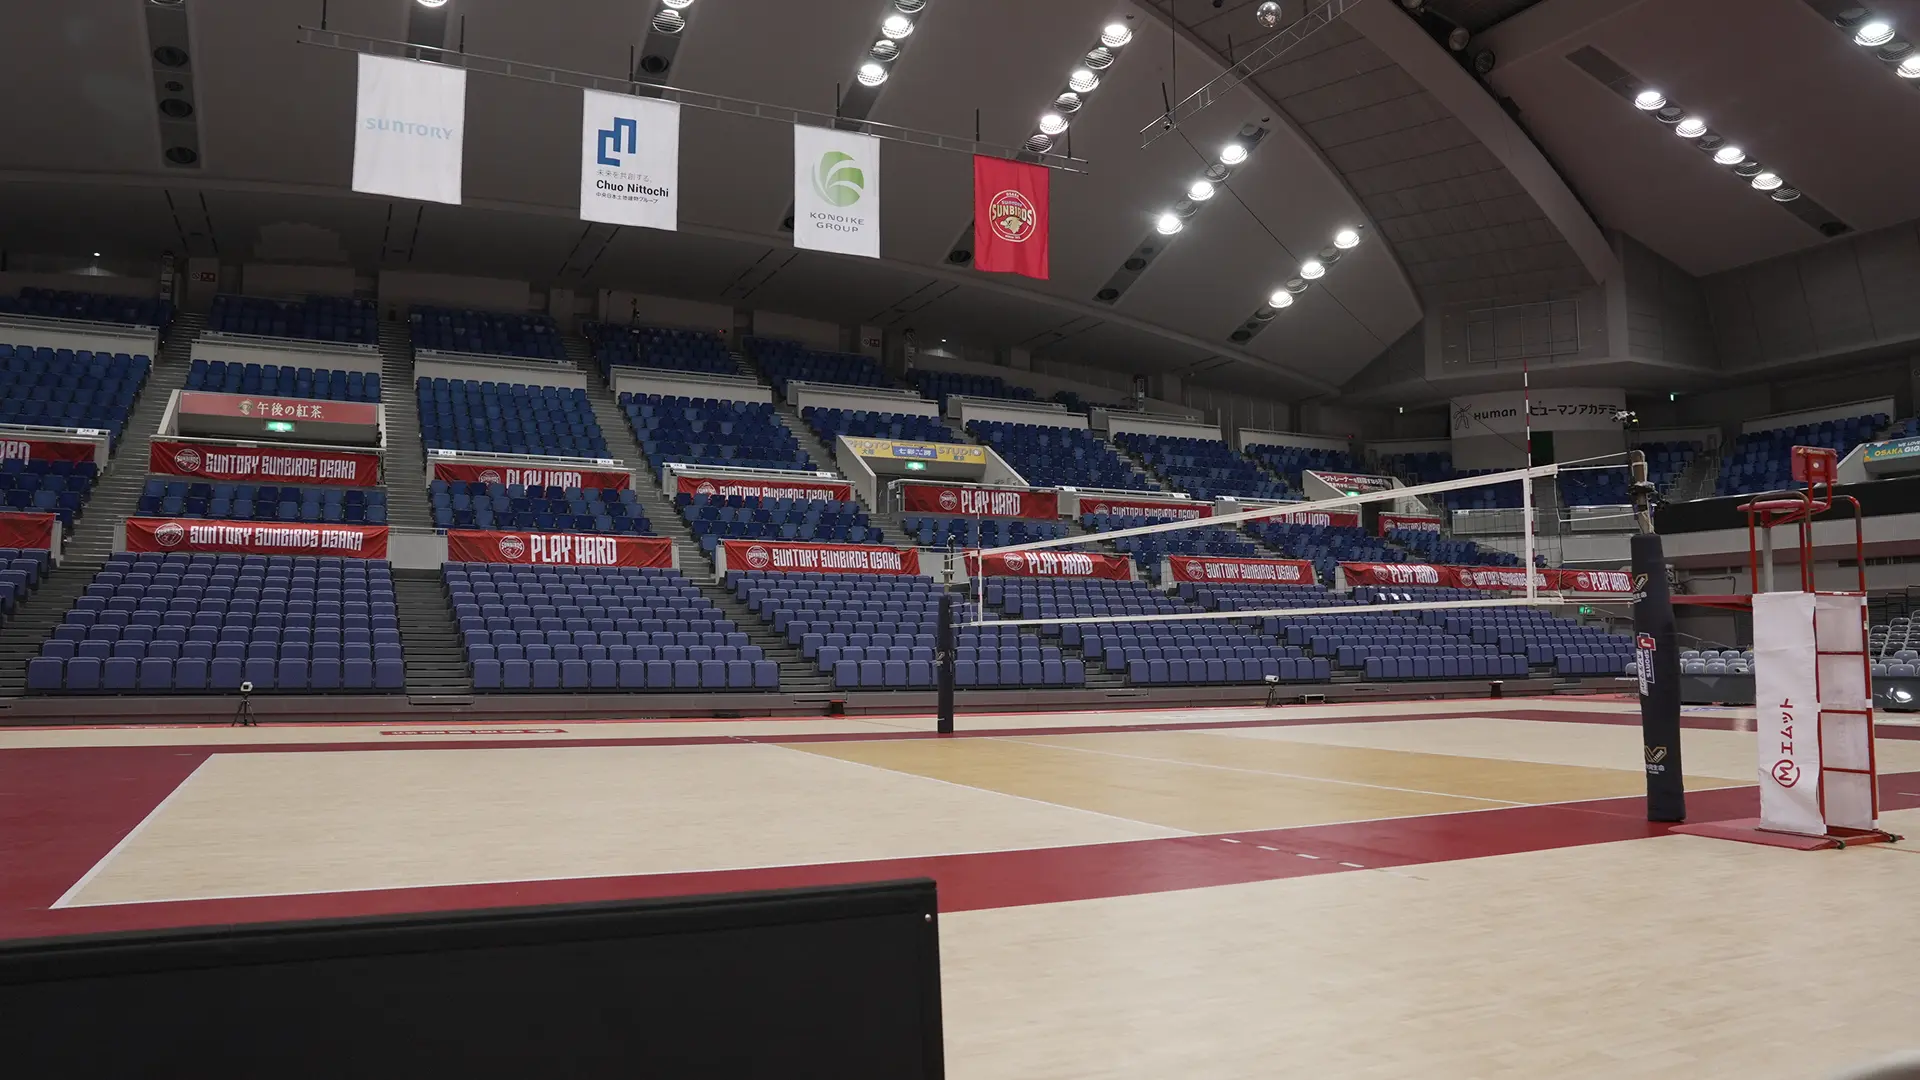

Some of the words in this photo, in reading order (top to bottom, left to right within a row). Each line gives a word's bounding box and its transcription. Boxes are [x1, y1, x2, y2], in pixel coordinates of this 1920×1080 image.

[596, 179, 624, 192] Chuo
[627, 183, 669, 198] Nittochi
[809, 212, 865, 226] KONOIKE
[991, 204, 1033, 226] SUNBIRDS
[816, 221, 859, 233] GROUP
[256, 401, 323, 419] 午後の紅茶
[1874, 447, 1904, 457] OSAKA
[205, 453, 259, 474] SUNTORY
[261, 456, 318, 477] SUNBIRDS
[319, 459, 356, 480] OSAKA
[960, 489, 990, 514] PLAY
[991, 491, 1021, 515] HARD
[190, 525, 252, 546] SUNTORY
[254, 528, 319, 548] SUNBIRDS
[321, 529, 364, 551] OSAKA
[530, 534, 571, 563] PLAY
[575, 536, 618, 565] HARD
[772, 548, 818, 568] SUNTORY
[820, 550, 869, 569] SUNBIRDS
[870, 551, 902, 570] OSAKA
[1024, 552, 1059, 575] PLAY
[1058, 553, 1093, 575] HARD
[1205, 563, 1239, 579] SUNTORY
[1240, 563, 1276, 580] SUNBIRDS
[1276, 565, 1300, 580] OSAKA
[1386, 565, 1414, 583] PLAY
[1589, 572, 1611, 591] PLAY
[1610, 573, 1631, 591] HARD
[1640, 638, 1652, 648] J
[1643, 649, 1652, 678] SPORTS
[1780, 698, 1793, 755] エムット
